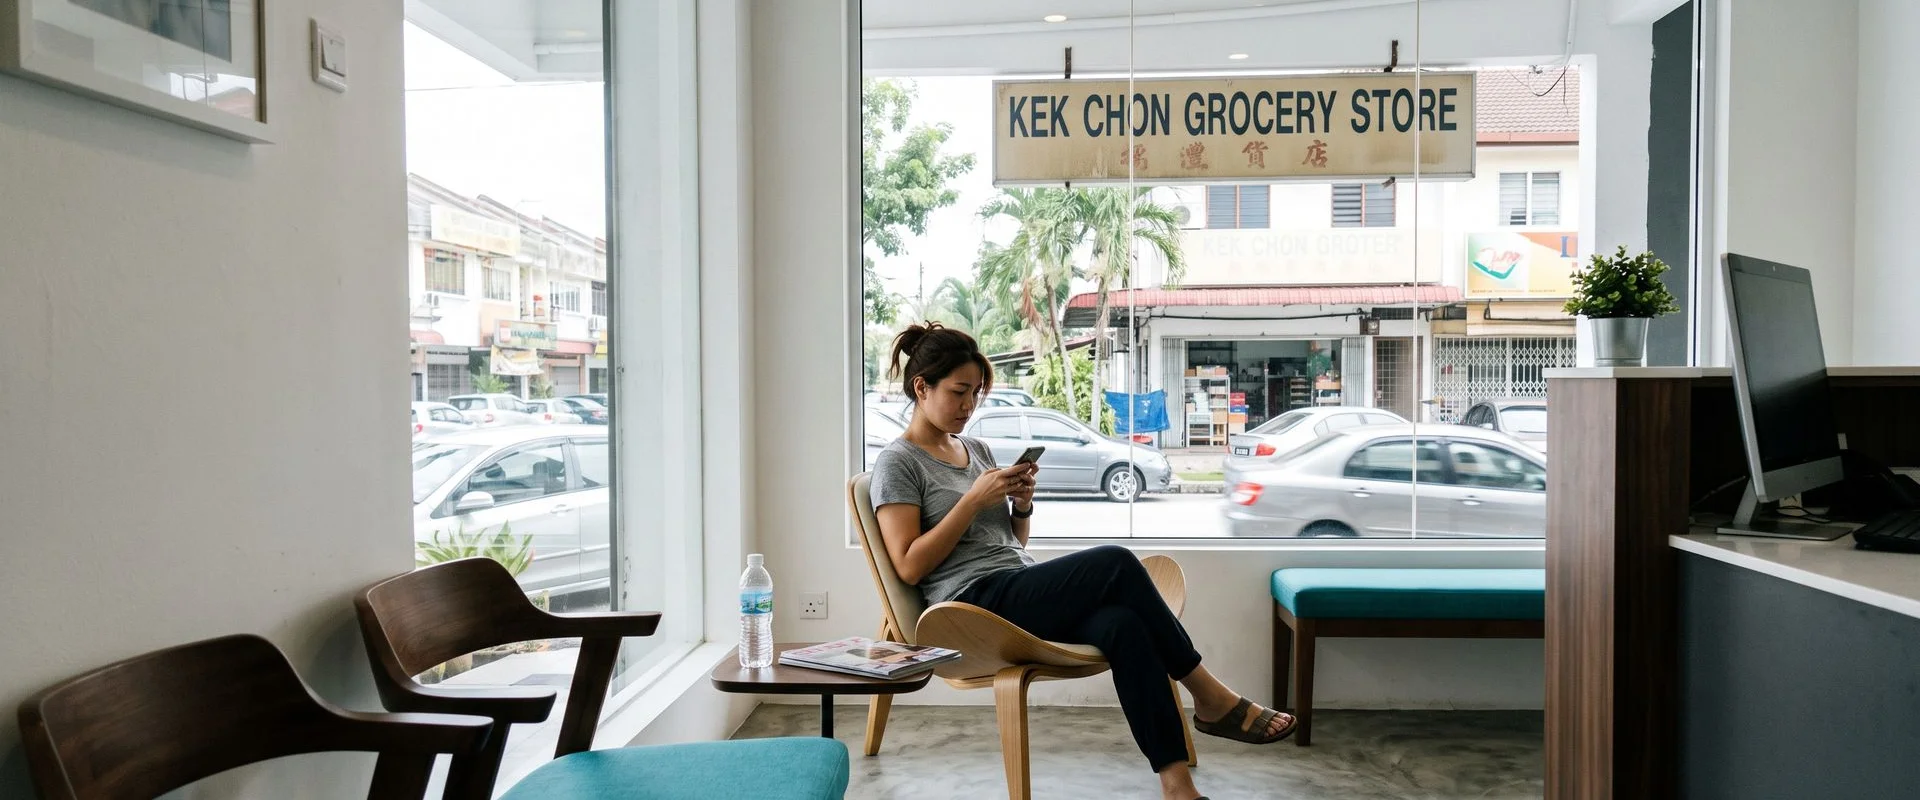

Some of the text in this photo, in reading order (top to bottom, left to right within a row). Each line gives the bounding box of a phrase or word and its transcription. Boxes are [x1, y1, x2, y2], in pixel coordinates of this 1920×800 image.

[1010, 88, 1457, 137] KEK CHON GROCERY STORE
